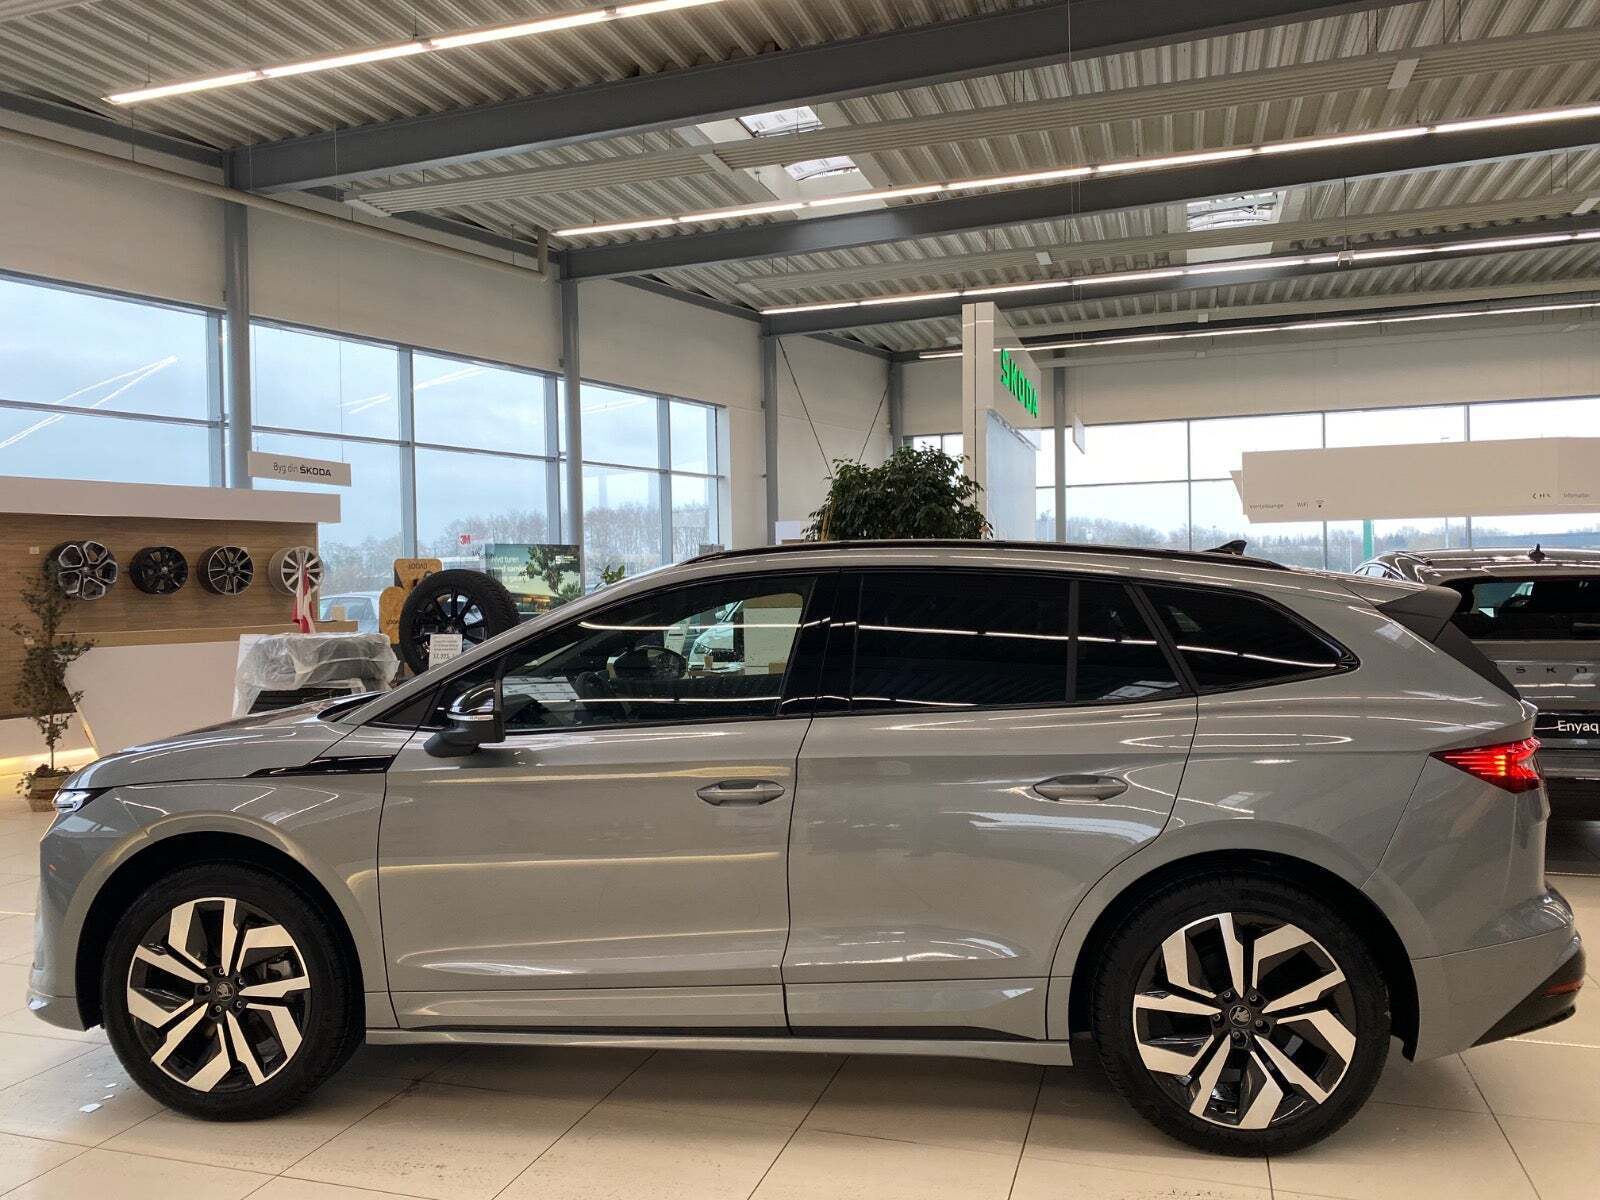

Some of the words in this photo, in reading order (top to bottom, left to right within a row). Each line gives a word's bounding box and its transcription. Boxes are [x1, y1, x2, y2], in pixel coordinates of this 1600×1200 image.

[273, 462, 286, 474] Byg
[287, 464, 297, 473] din
[299, 463, 332, 477] ŠKODA
[460, 535, 471, 545] 3M
[1557, 720, 1600, 734] Enyaq
